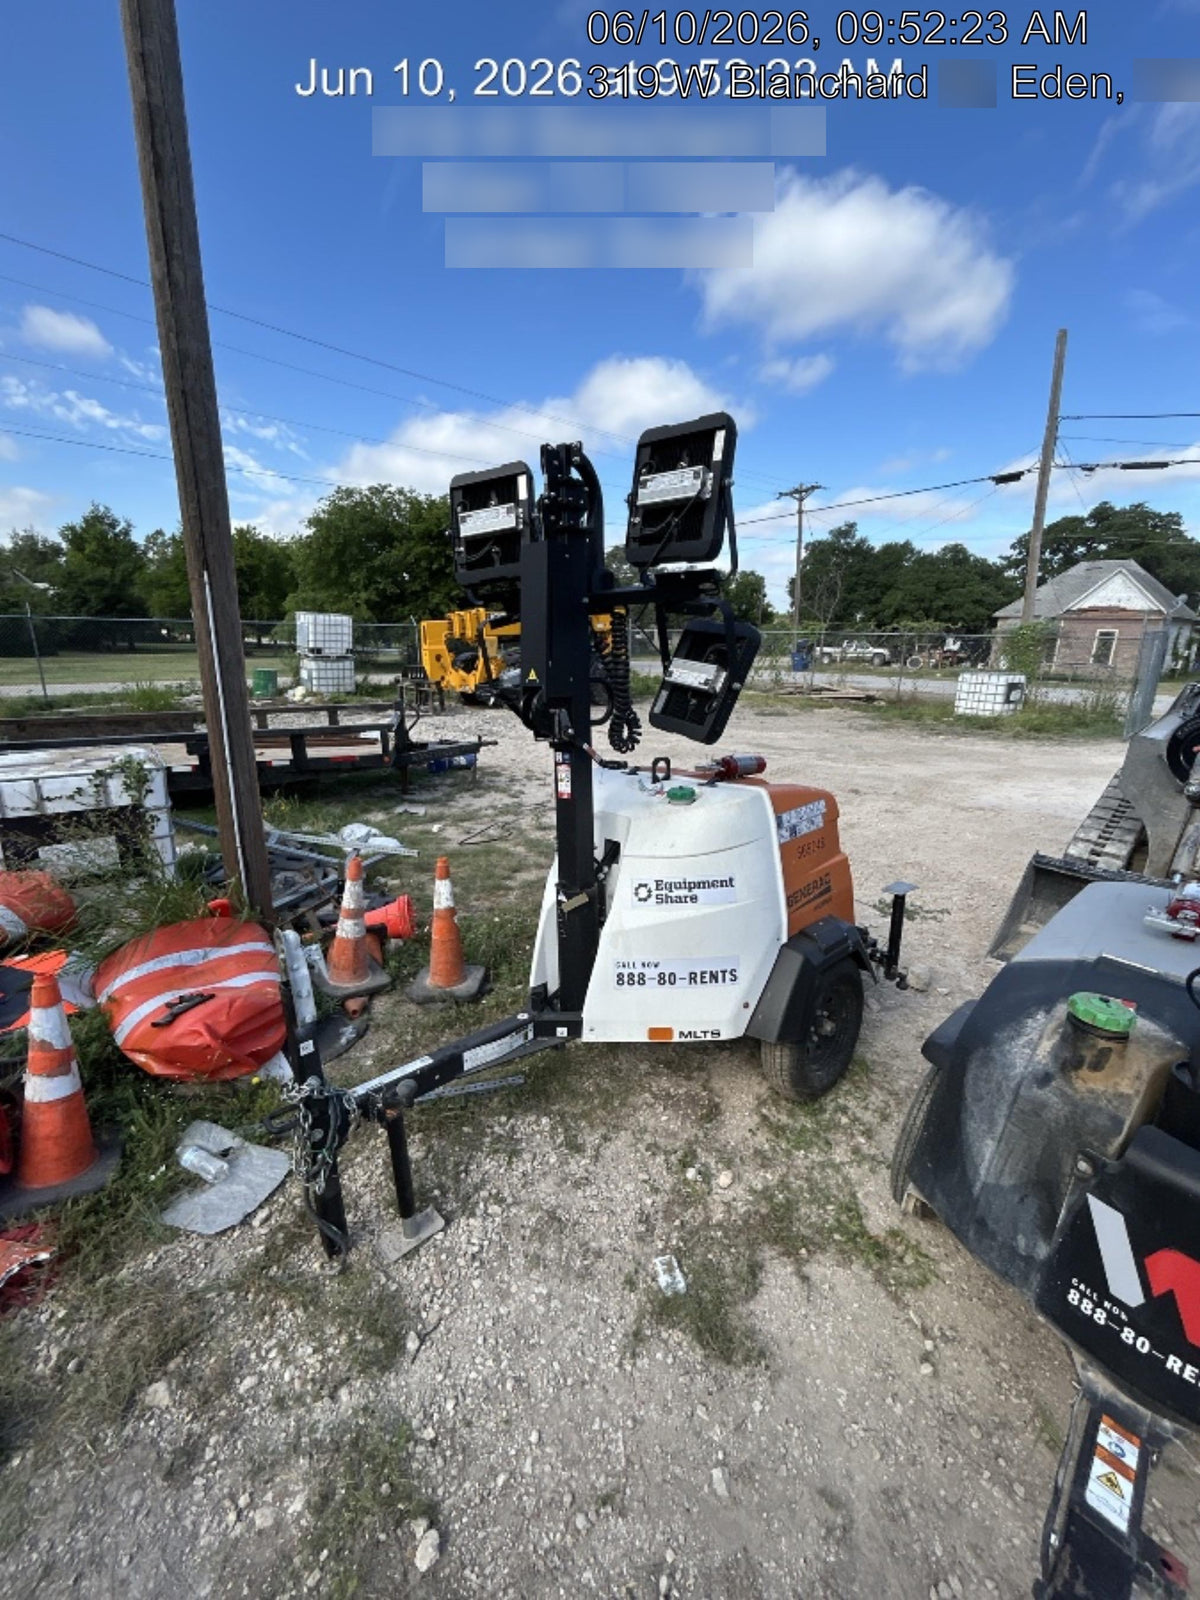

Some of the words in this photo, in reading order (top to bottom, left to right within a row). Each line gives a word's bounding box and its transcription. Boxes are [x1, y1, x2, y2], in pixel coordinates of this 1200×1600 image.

[654, 877, 735, 893] Equipment
[655, 894, 699, 905] Share
[616, 968, 738, 987] 888-80-RENTS
[1071, 1277, 1098, 1301] CALL
